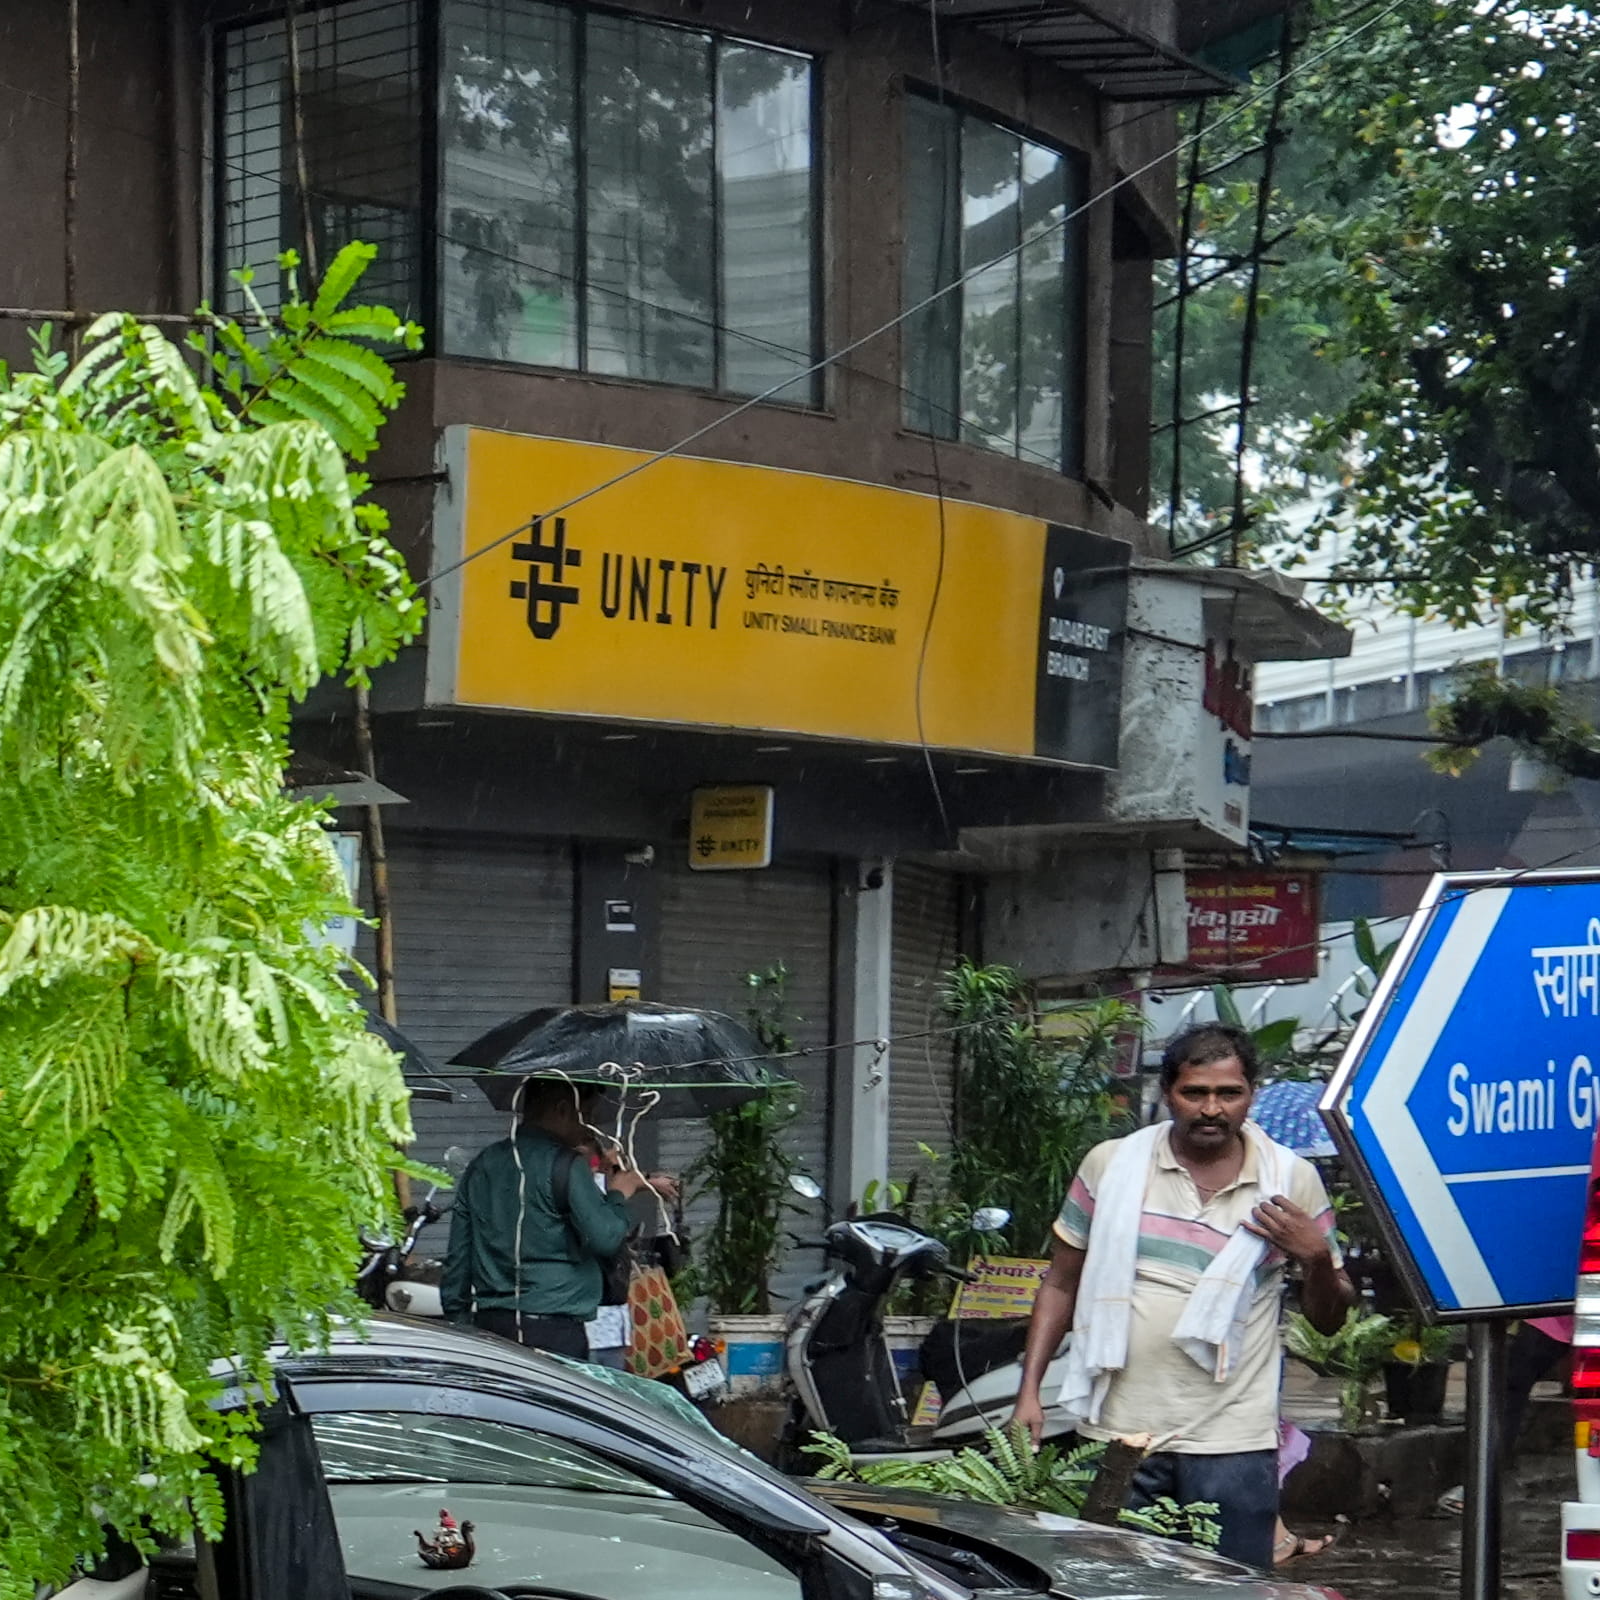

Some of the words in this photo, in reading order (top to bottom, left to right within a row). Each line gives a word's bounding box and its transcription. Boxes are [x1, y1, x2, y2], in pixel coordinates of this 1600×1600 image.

[600, 551, 727, 630] UNITY
[745, 562, 784, 600] युनिटी
[743, 611, 779, 632] UNITY
[781, 615, 818, 636] SMALL
[822, 619, 867, 642] FINANCE
[869, 625, 897, 645] BANK
[1048, 616, 1085, 647] DADAR
[1085, 624, 1111, 652] EAST
[1047, 650, 1090, 681] BRANCH
[1447, 1059, 1555, 1137] Swami
